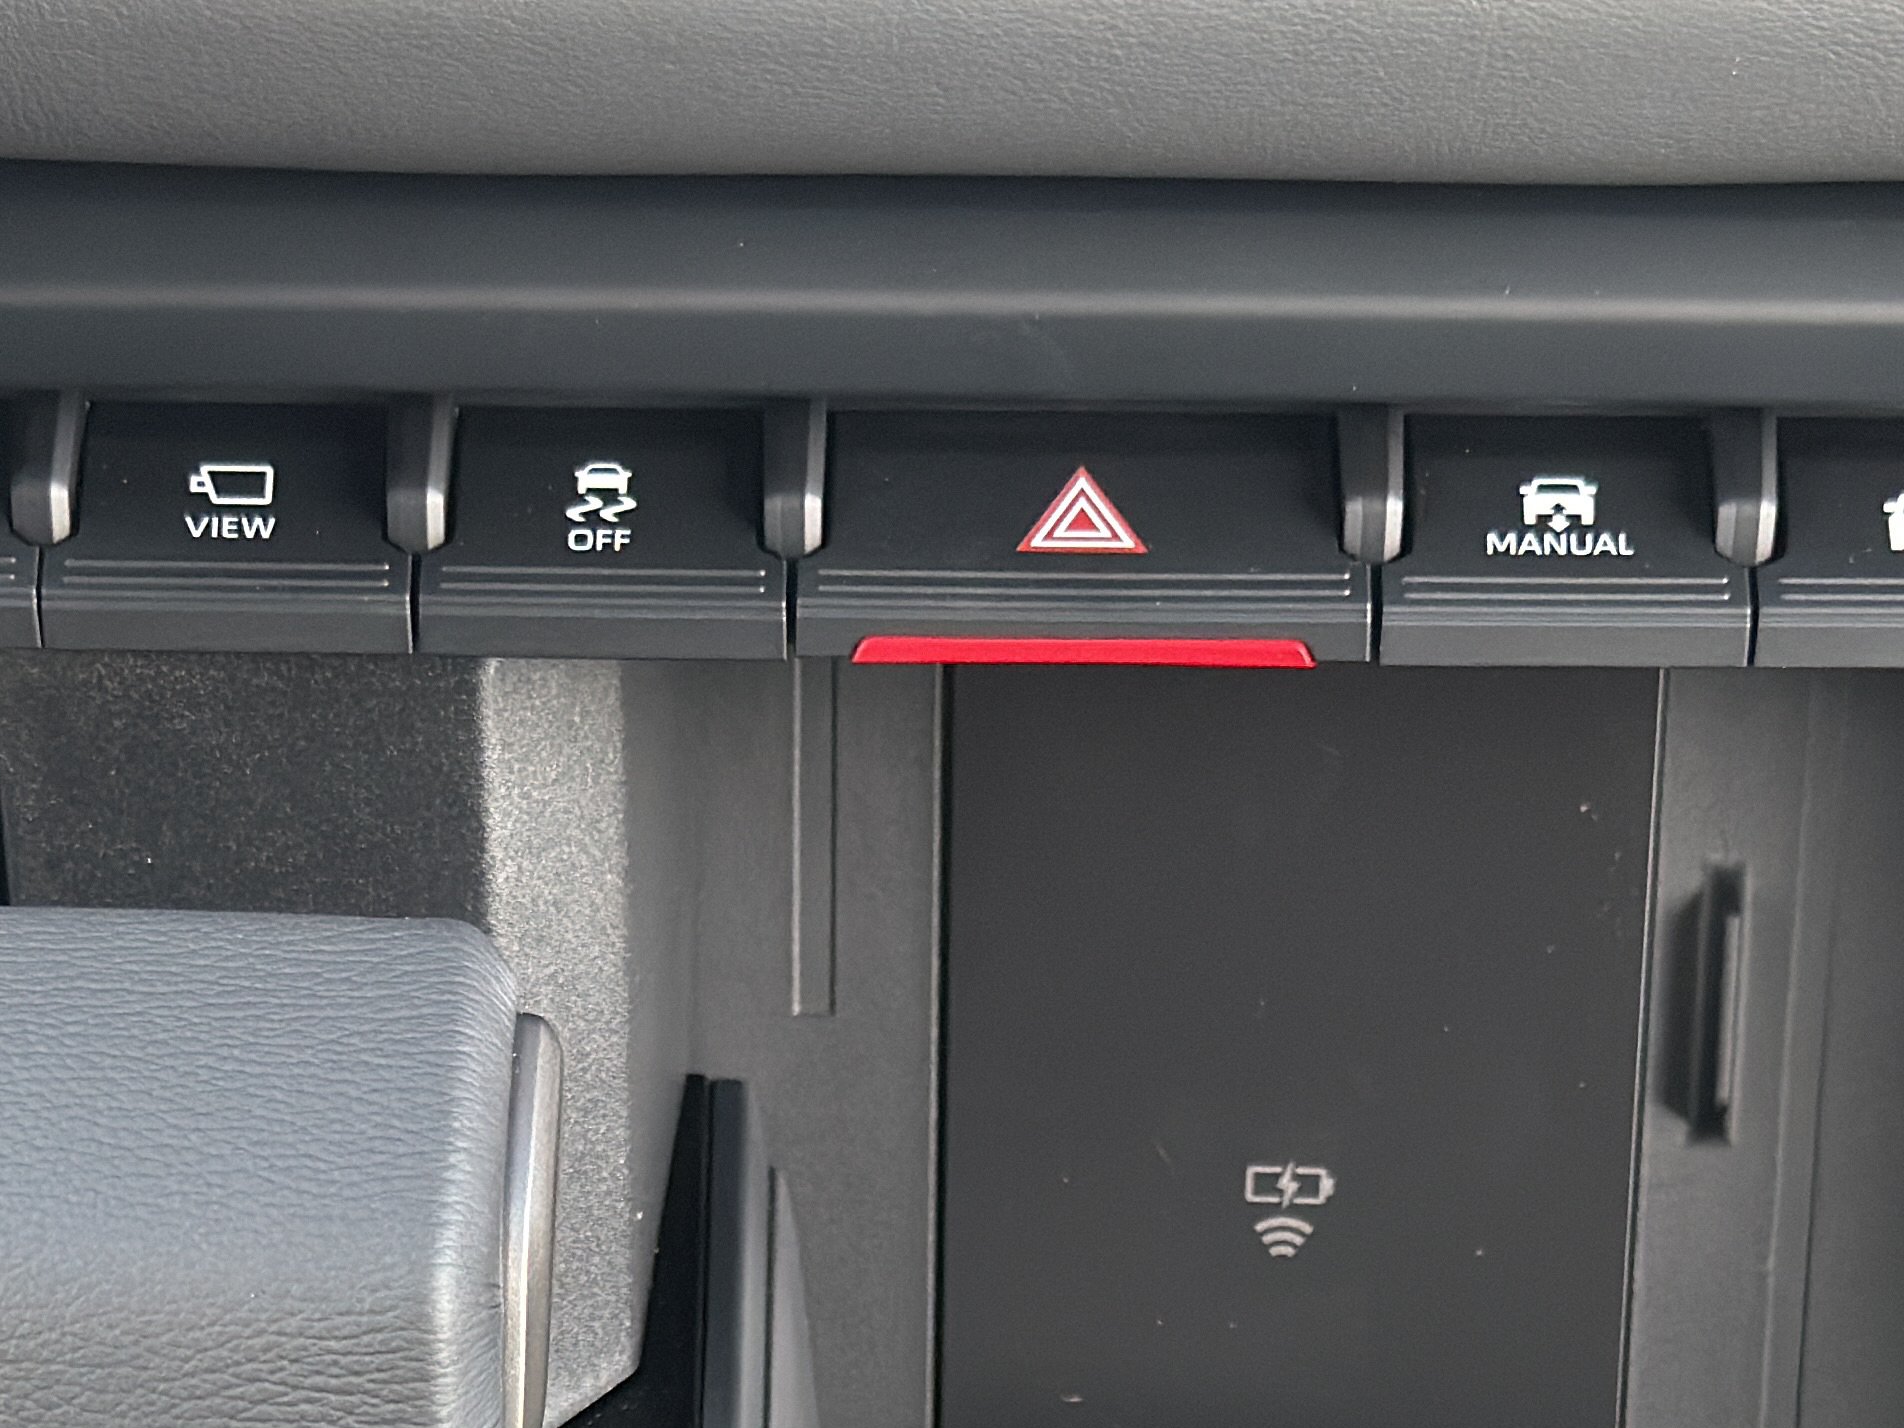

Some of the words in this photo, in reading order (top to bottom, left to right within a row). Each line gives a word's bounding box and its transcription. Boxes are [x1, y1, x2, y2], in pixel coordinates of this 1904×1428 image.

[184, 514, 276, 539] VIEW
[567, 528, 632, 552] OFF
[1486, 532, 1635, 556] MANUAL
